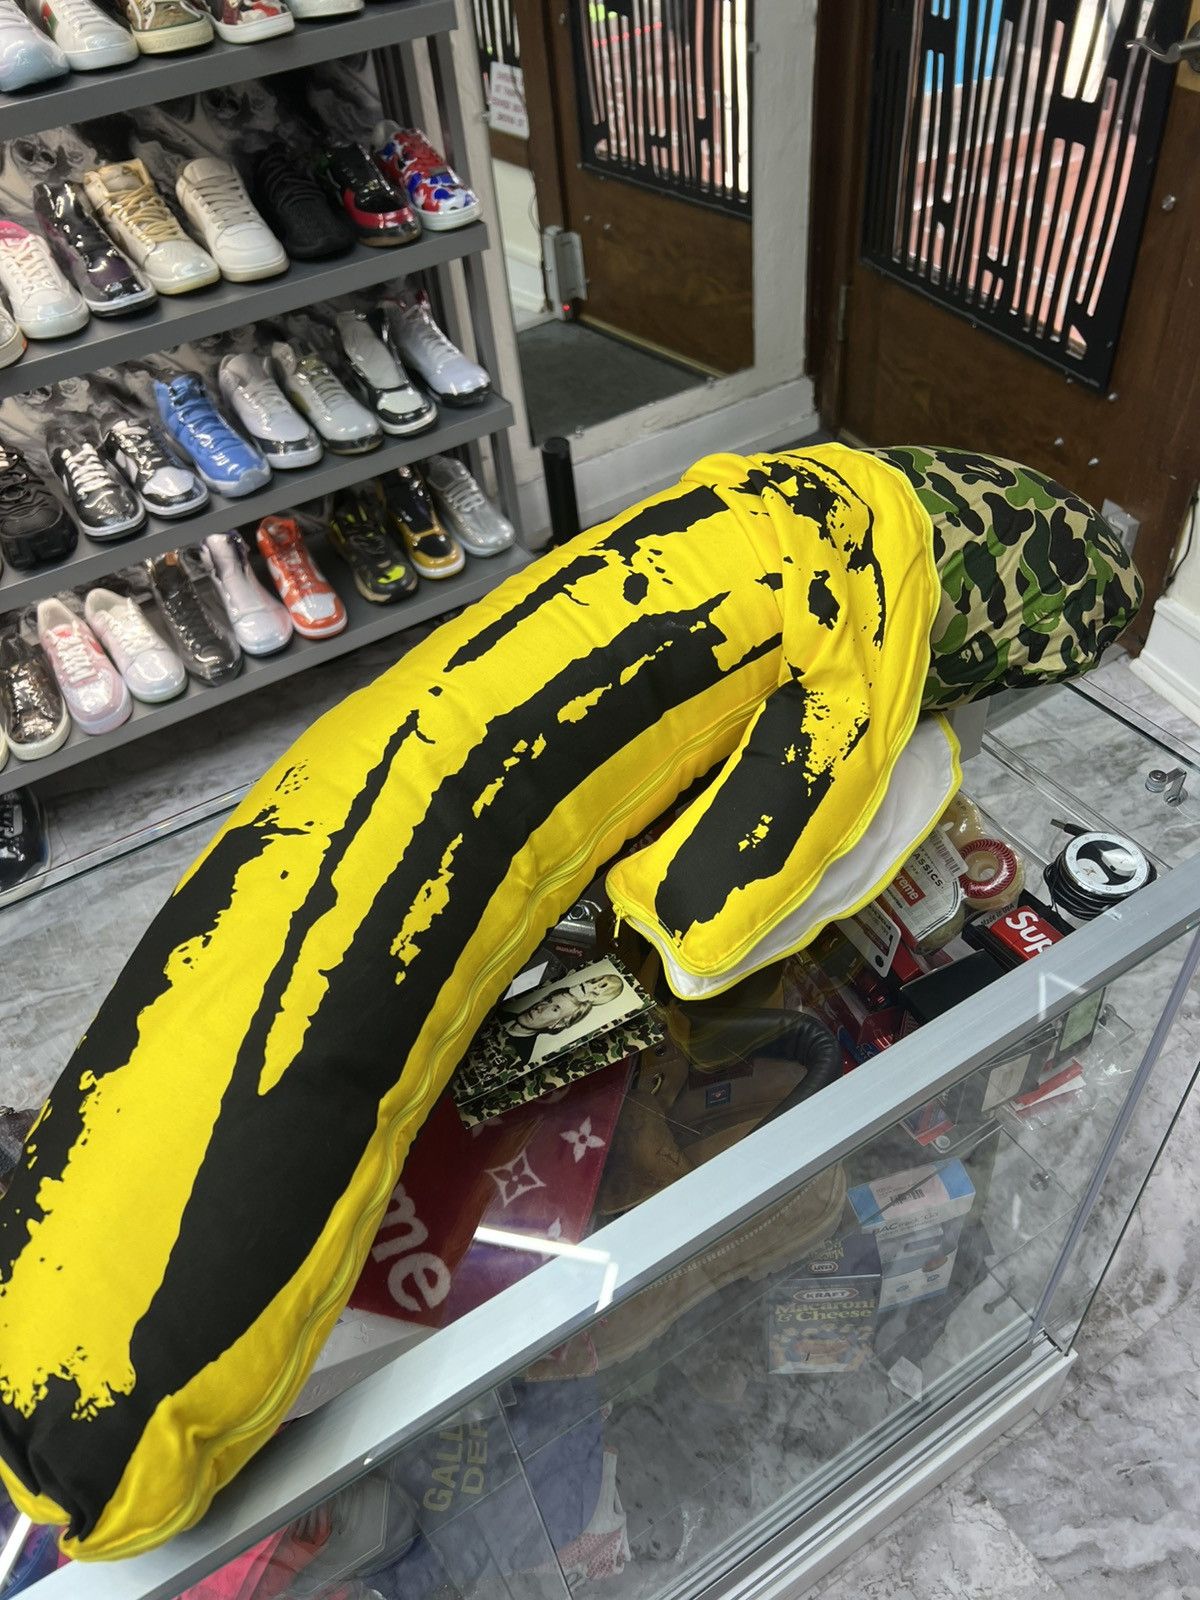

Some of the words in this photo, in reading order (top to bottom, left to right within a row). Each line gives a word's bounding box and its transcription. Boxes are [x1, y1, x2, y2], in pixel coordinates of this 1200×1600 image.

[806, 1290, 847, 1299] KRAFT
[775, 1299, 876, 1315] Macaroni
[796, 1309, 873, 1321] Cheese
